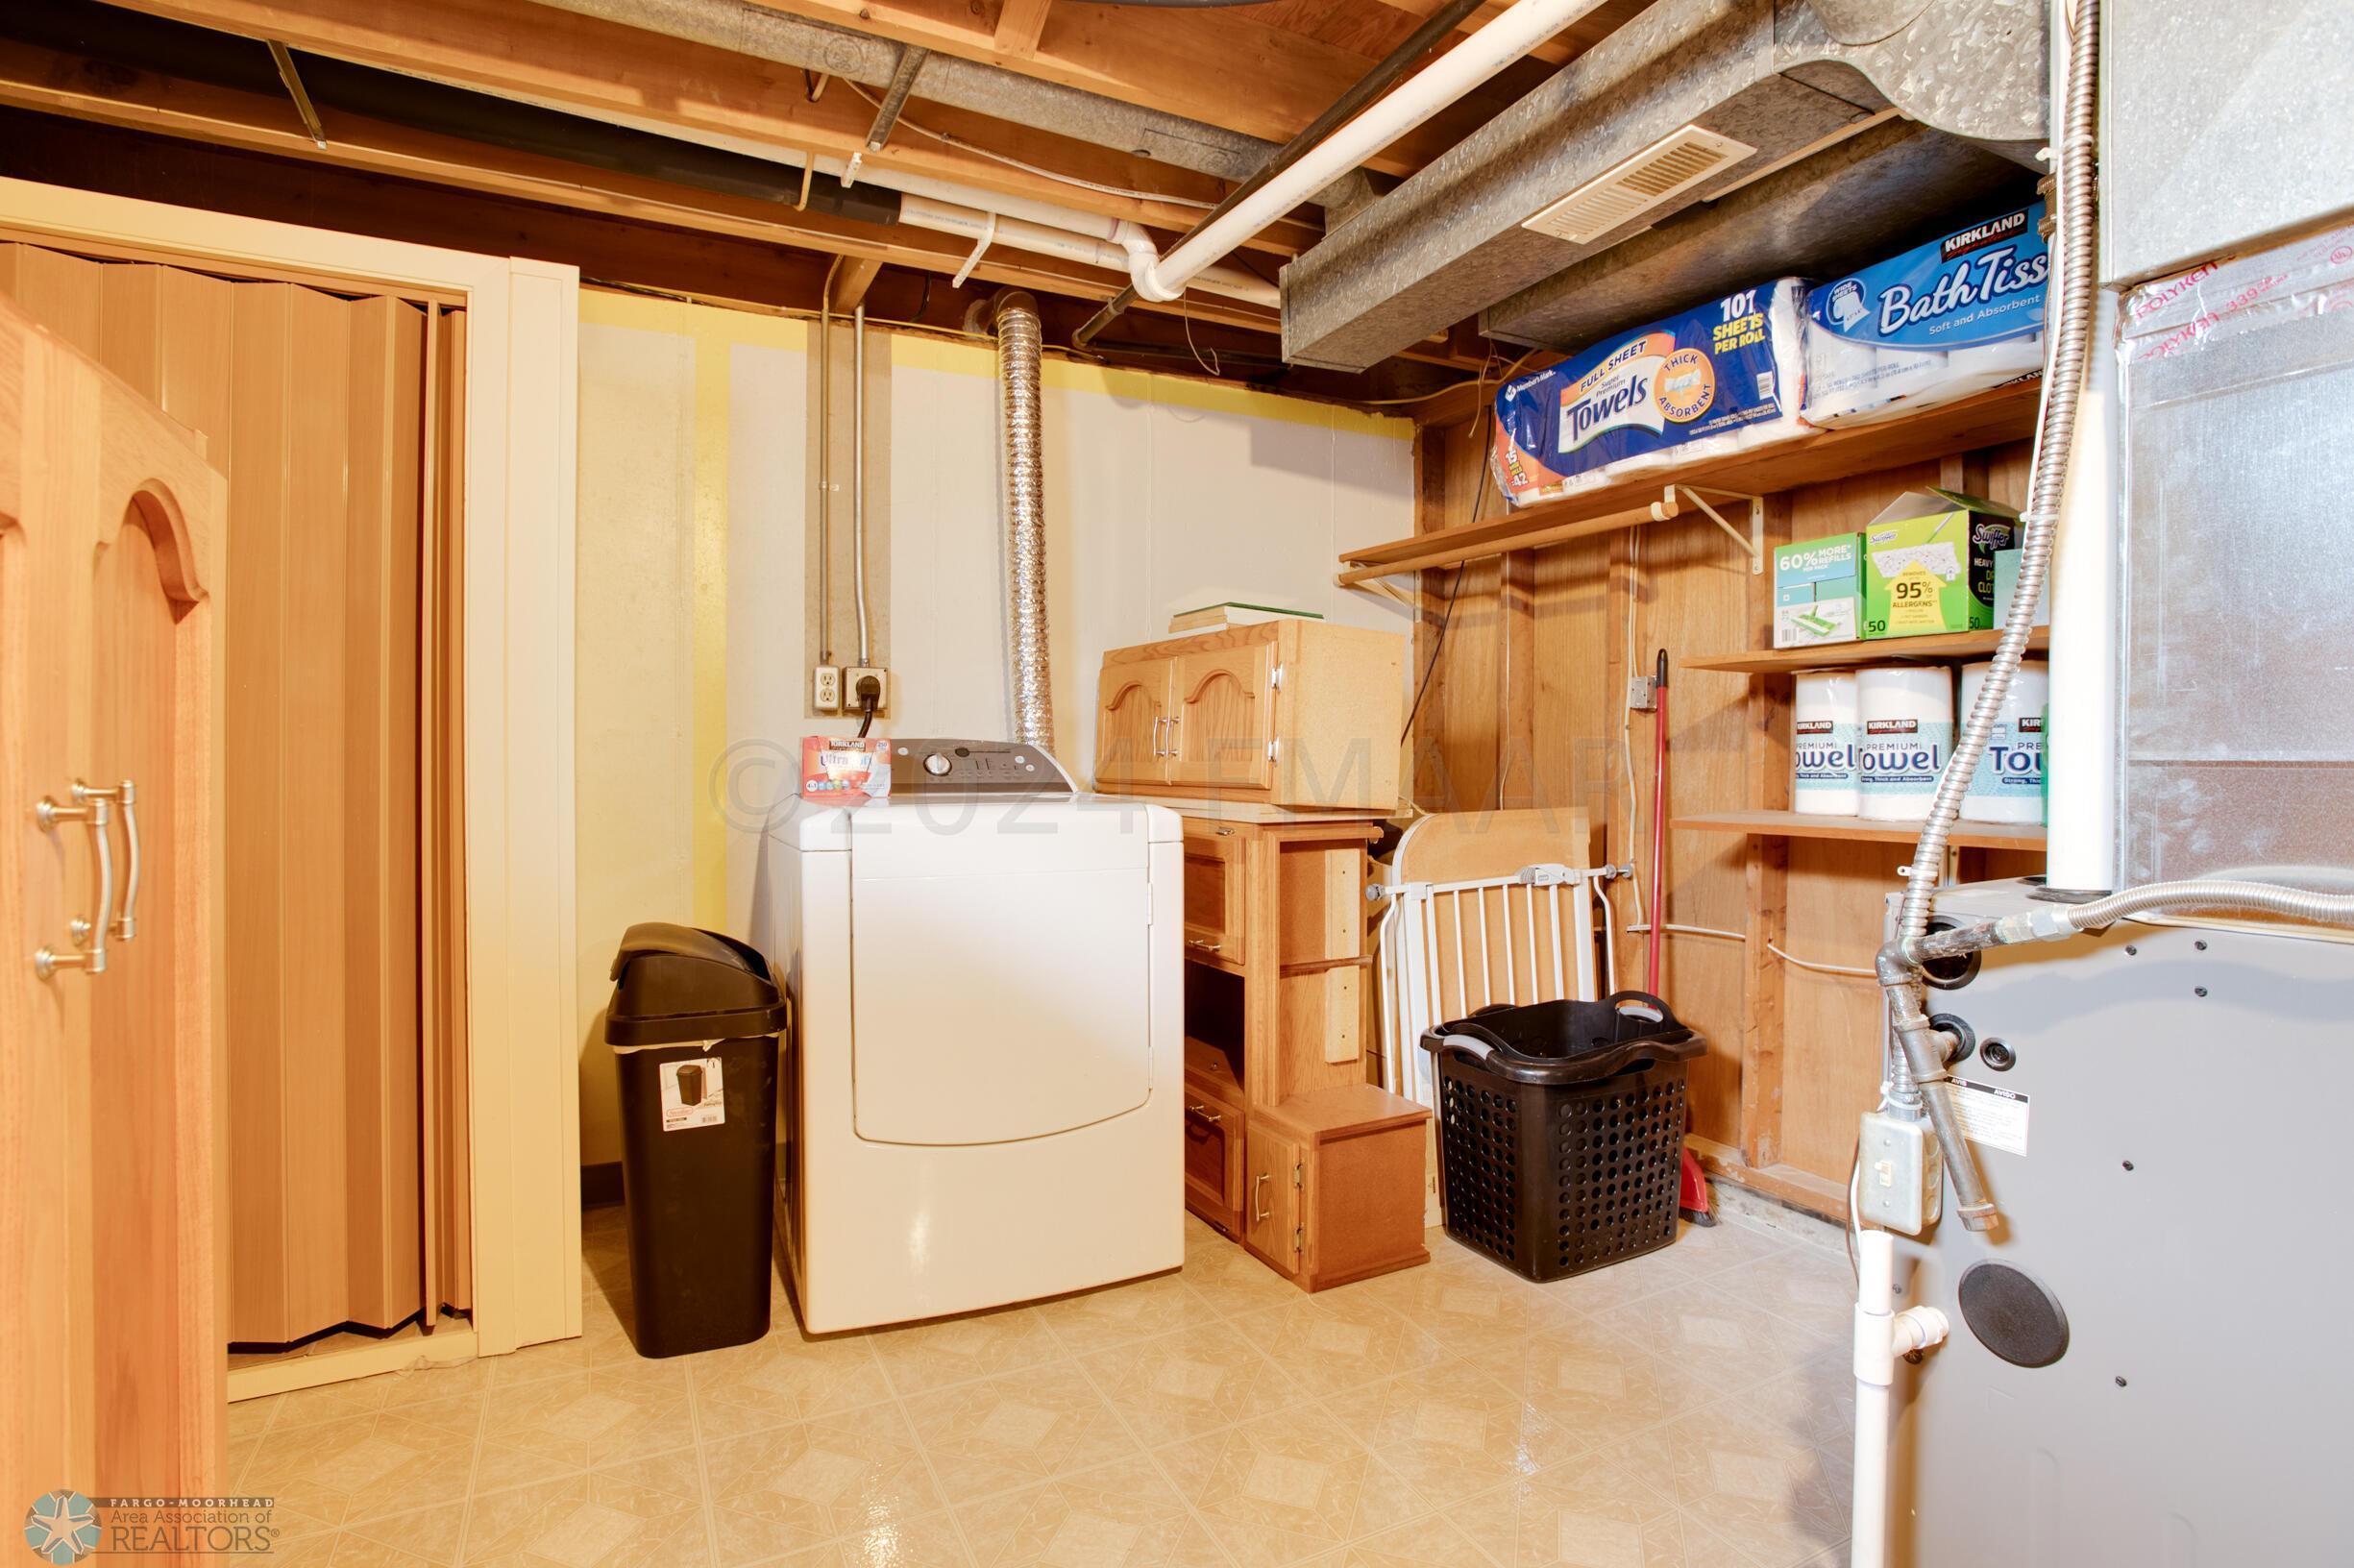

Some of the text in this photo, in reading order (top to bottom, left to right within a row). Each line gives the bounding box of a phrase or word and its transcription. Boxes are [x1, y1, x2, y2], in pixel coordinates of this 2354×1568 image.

[1945, 212, 2025, 253] KIRKLAND
[1720, 289, 1757, 322] 101
[1880, 260, 1978, 334] Bath
[1713, 312, 1765, 341] SHEETS
[1928, 295, 2041, 335] Soft and Absorbent
[1714, 329, 1766, 355] PER ROLL
[1580, 340, 1648, 392] FULL SHEET
[1663, 354, 1699, 373] THICK
[1566, 374, 1649, 442] Towels
[1658, 383, 1712, 418] ABSORBENT
[1973, 524, 2010, 549] Swiffer
[1779, 551, 1818, 571] 60%
[1818, 552, 1852, 565] REFILLS
[1896, 581, 1933, 600] 95%
[1868, 620, 1886, 632] 50
[1970, 616, 1980, 629] 50
[1868, 721, 1916, 730] KIRKLAND
[821, 753, 848, 766] Ultra
[1994, 1089, 2016, 1099] AVISO
